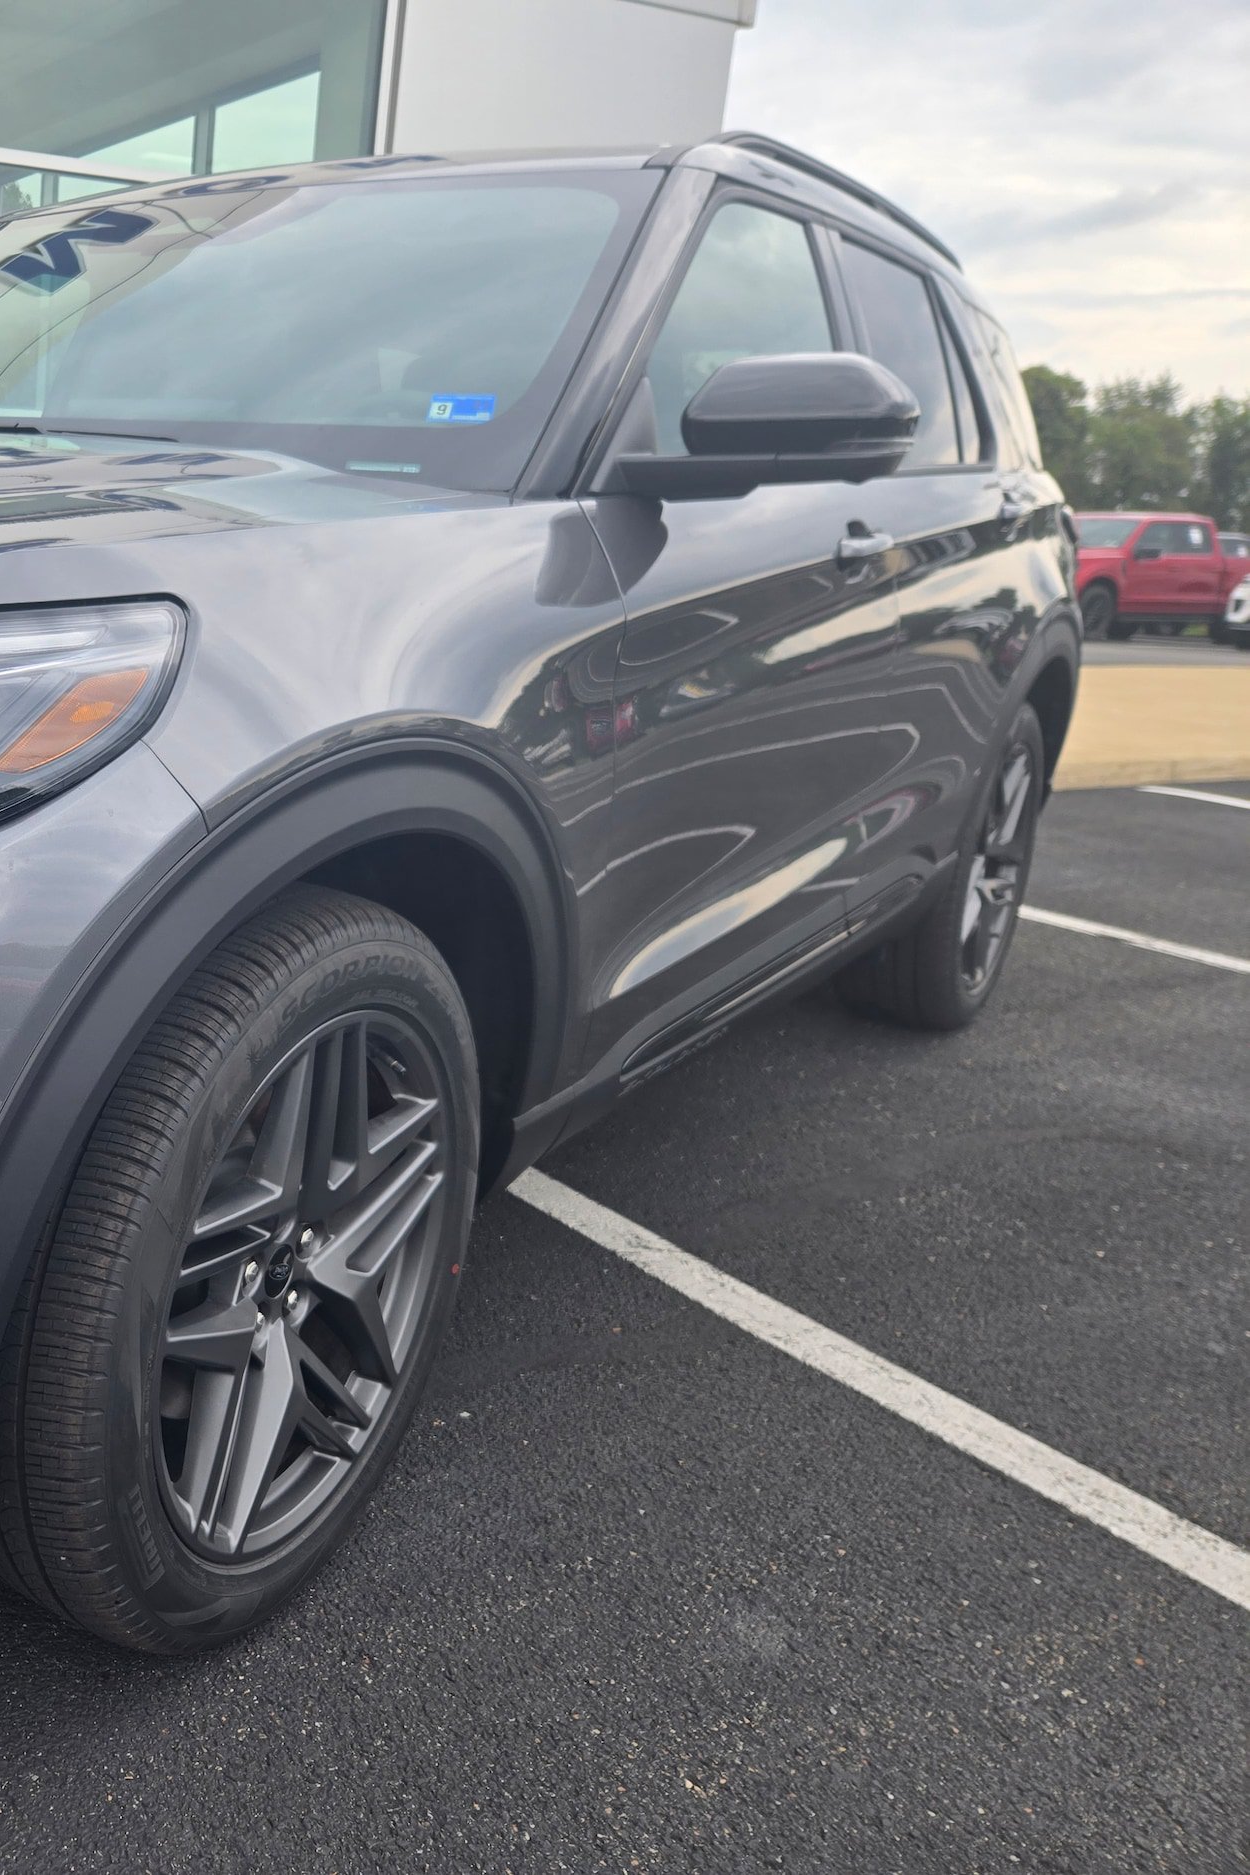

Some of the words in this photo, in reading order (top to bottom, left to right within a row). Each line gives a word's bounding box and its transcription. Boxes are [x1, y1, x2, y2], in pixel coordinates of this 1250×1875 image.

[436, 403, 448, 416] 9
[277, 954, 421, 1036] SCORPION
[129, 1483, 166, 1591] PIRELLI
